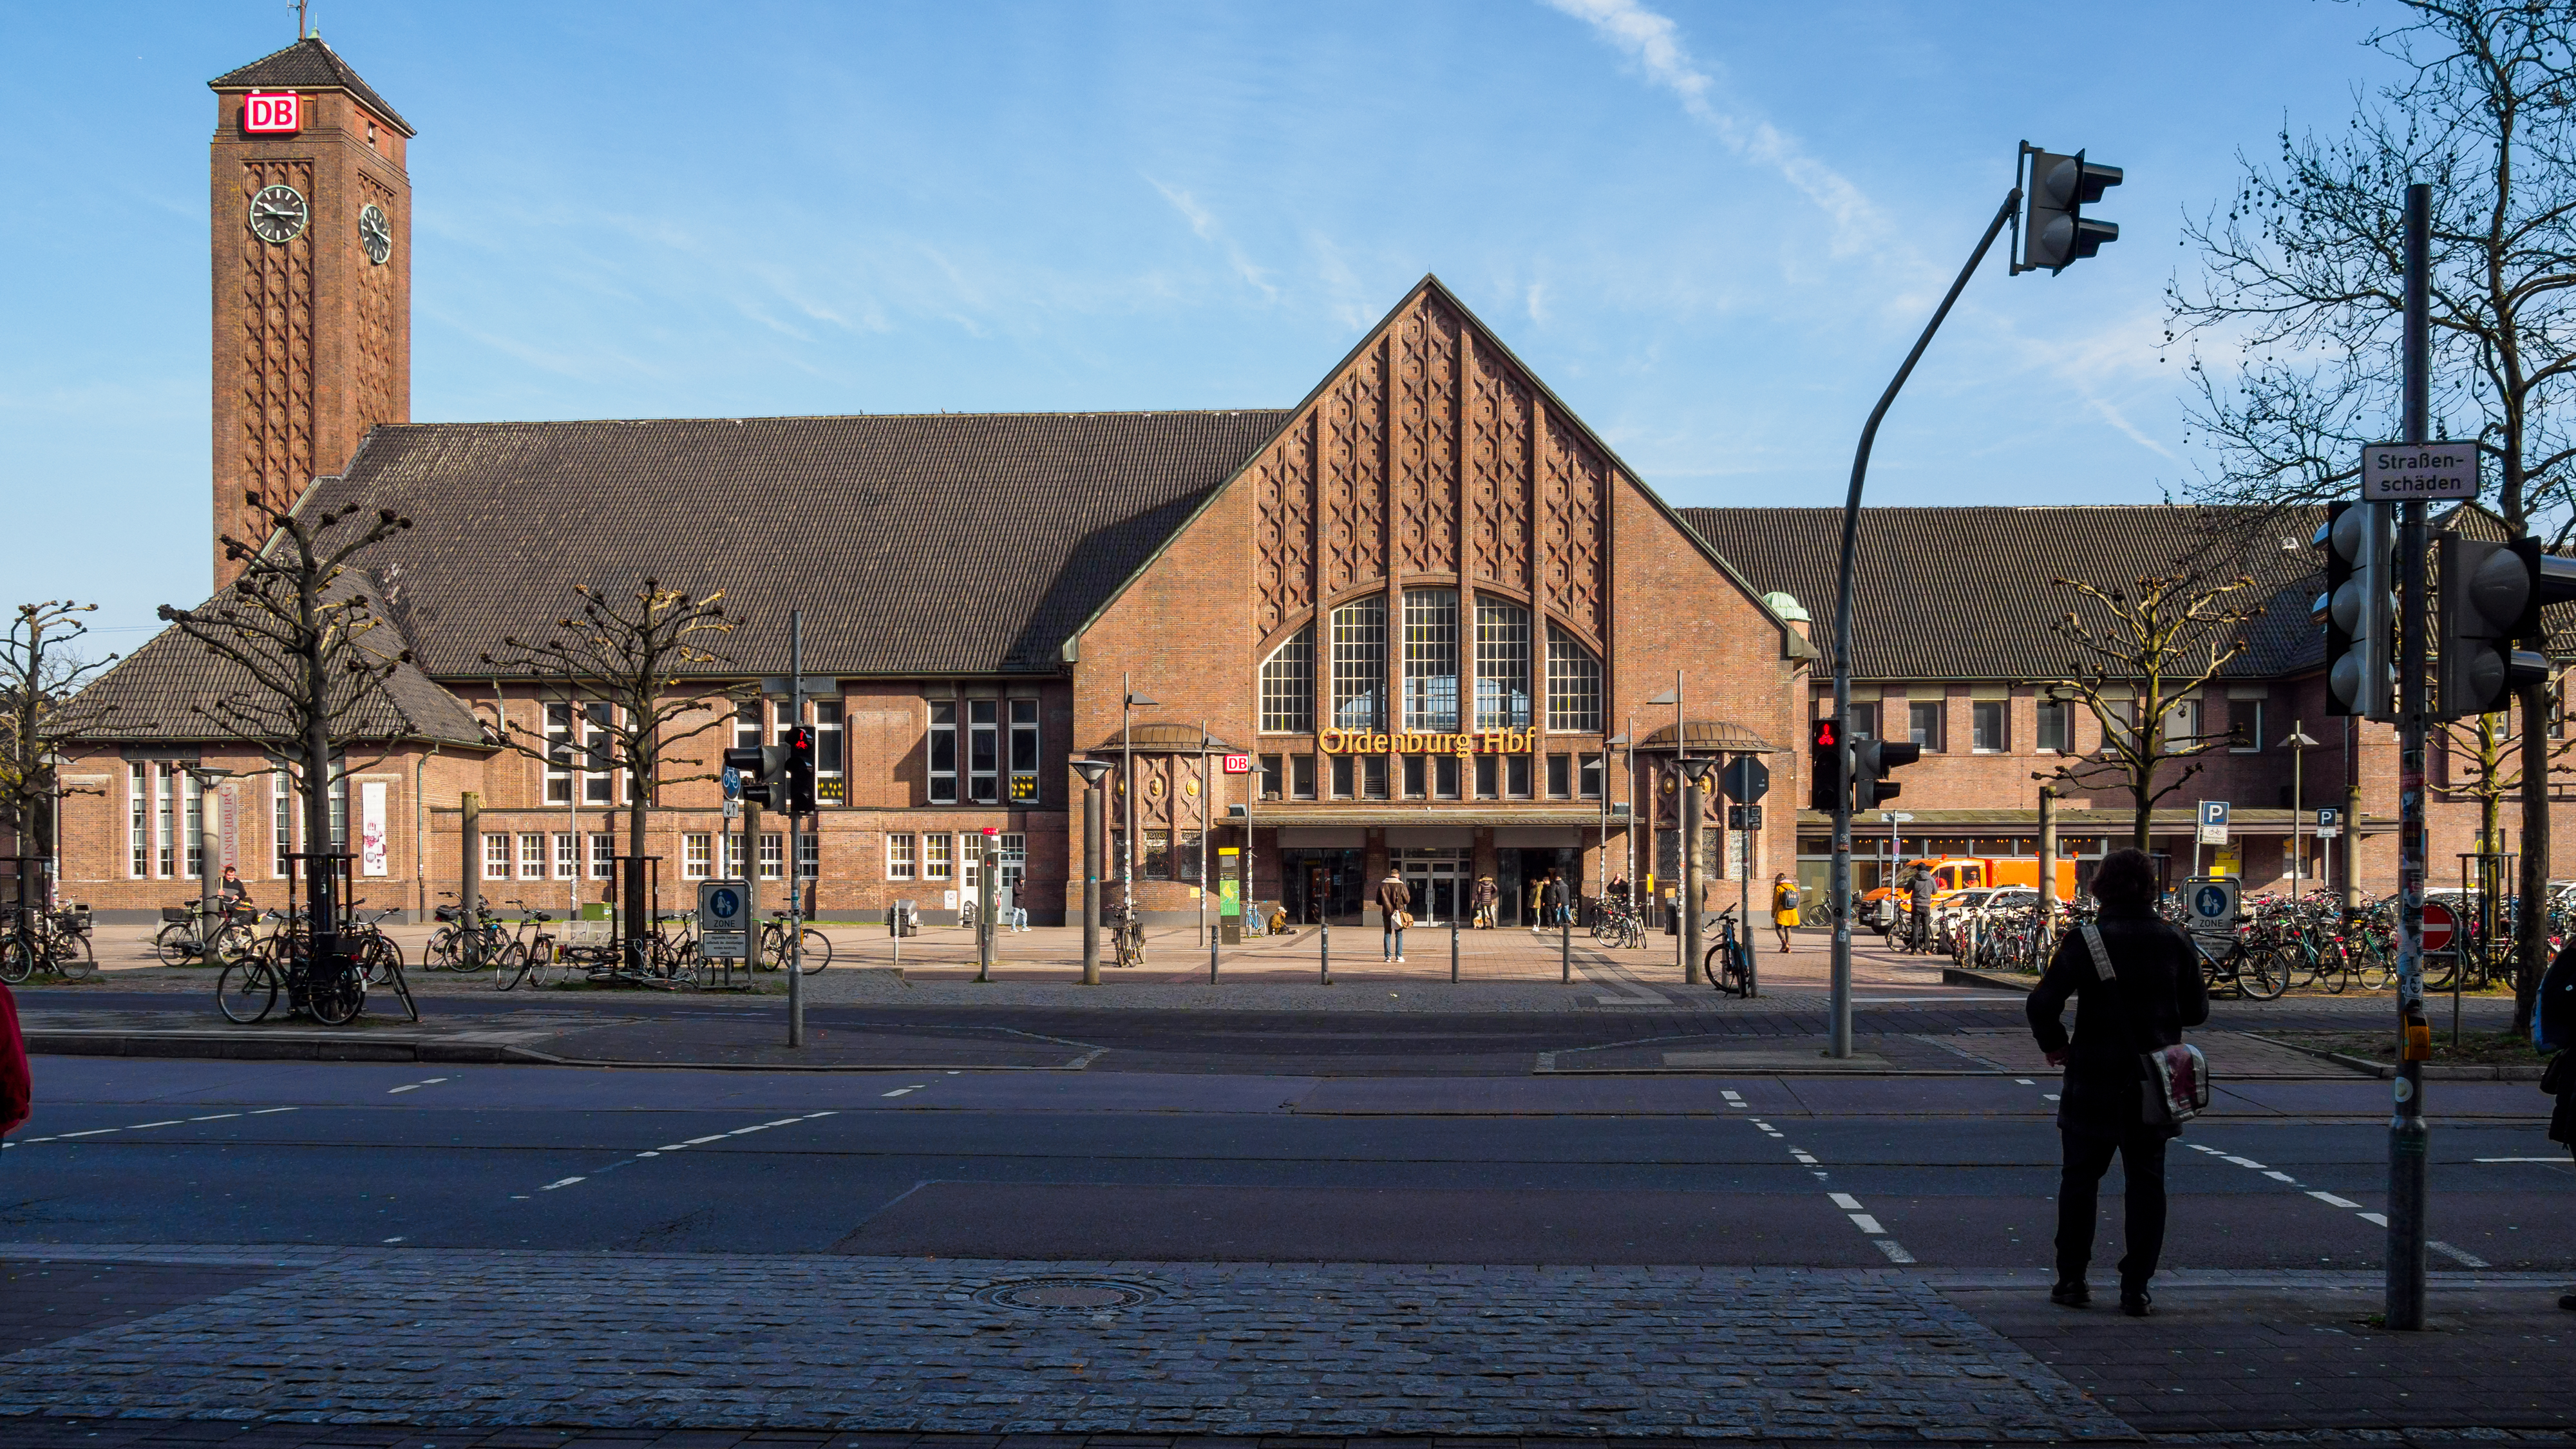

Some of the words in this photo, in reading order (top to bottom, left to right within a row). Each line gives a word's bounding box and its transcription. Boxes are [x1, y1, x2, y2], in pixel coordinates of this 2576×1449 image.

[253, 100, 292, 126] DB
[2377, 452, 2465, 470] Straßen-
[2380, 474, 2462, 493] schäden
[1318, 726, 1472, 758] Oldenburg
[1483, 726, 1537, 753] Hbf
[1229, 758, 1247, 769] DB
[2209, 805, 2222, 822] P
[2321, 811, 2332, 824] P
[2199, 919, 2224, 927] ZONE
